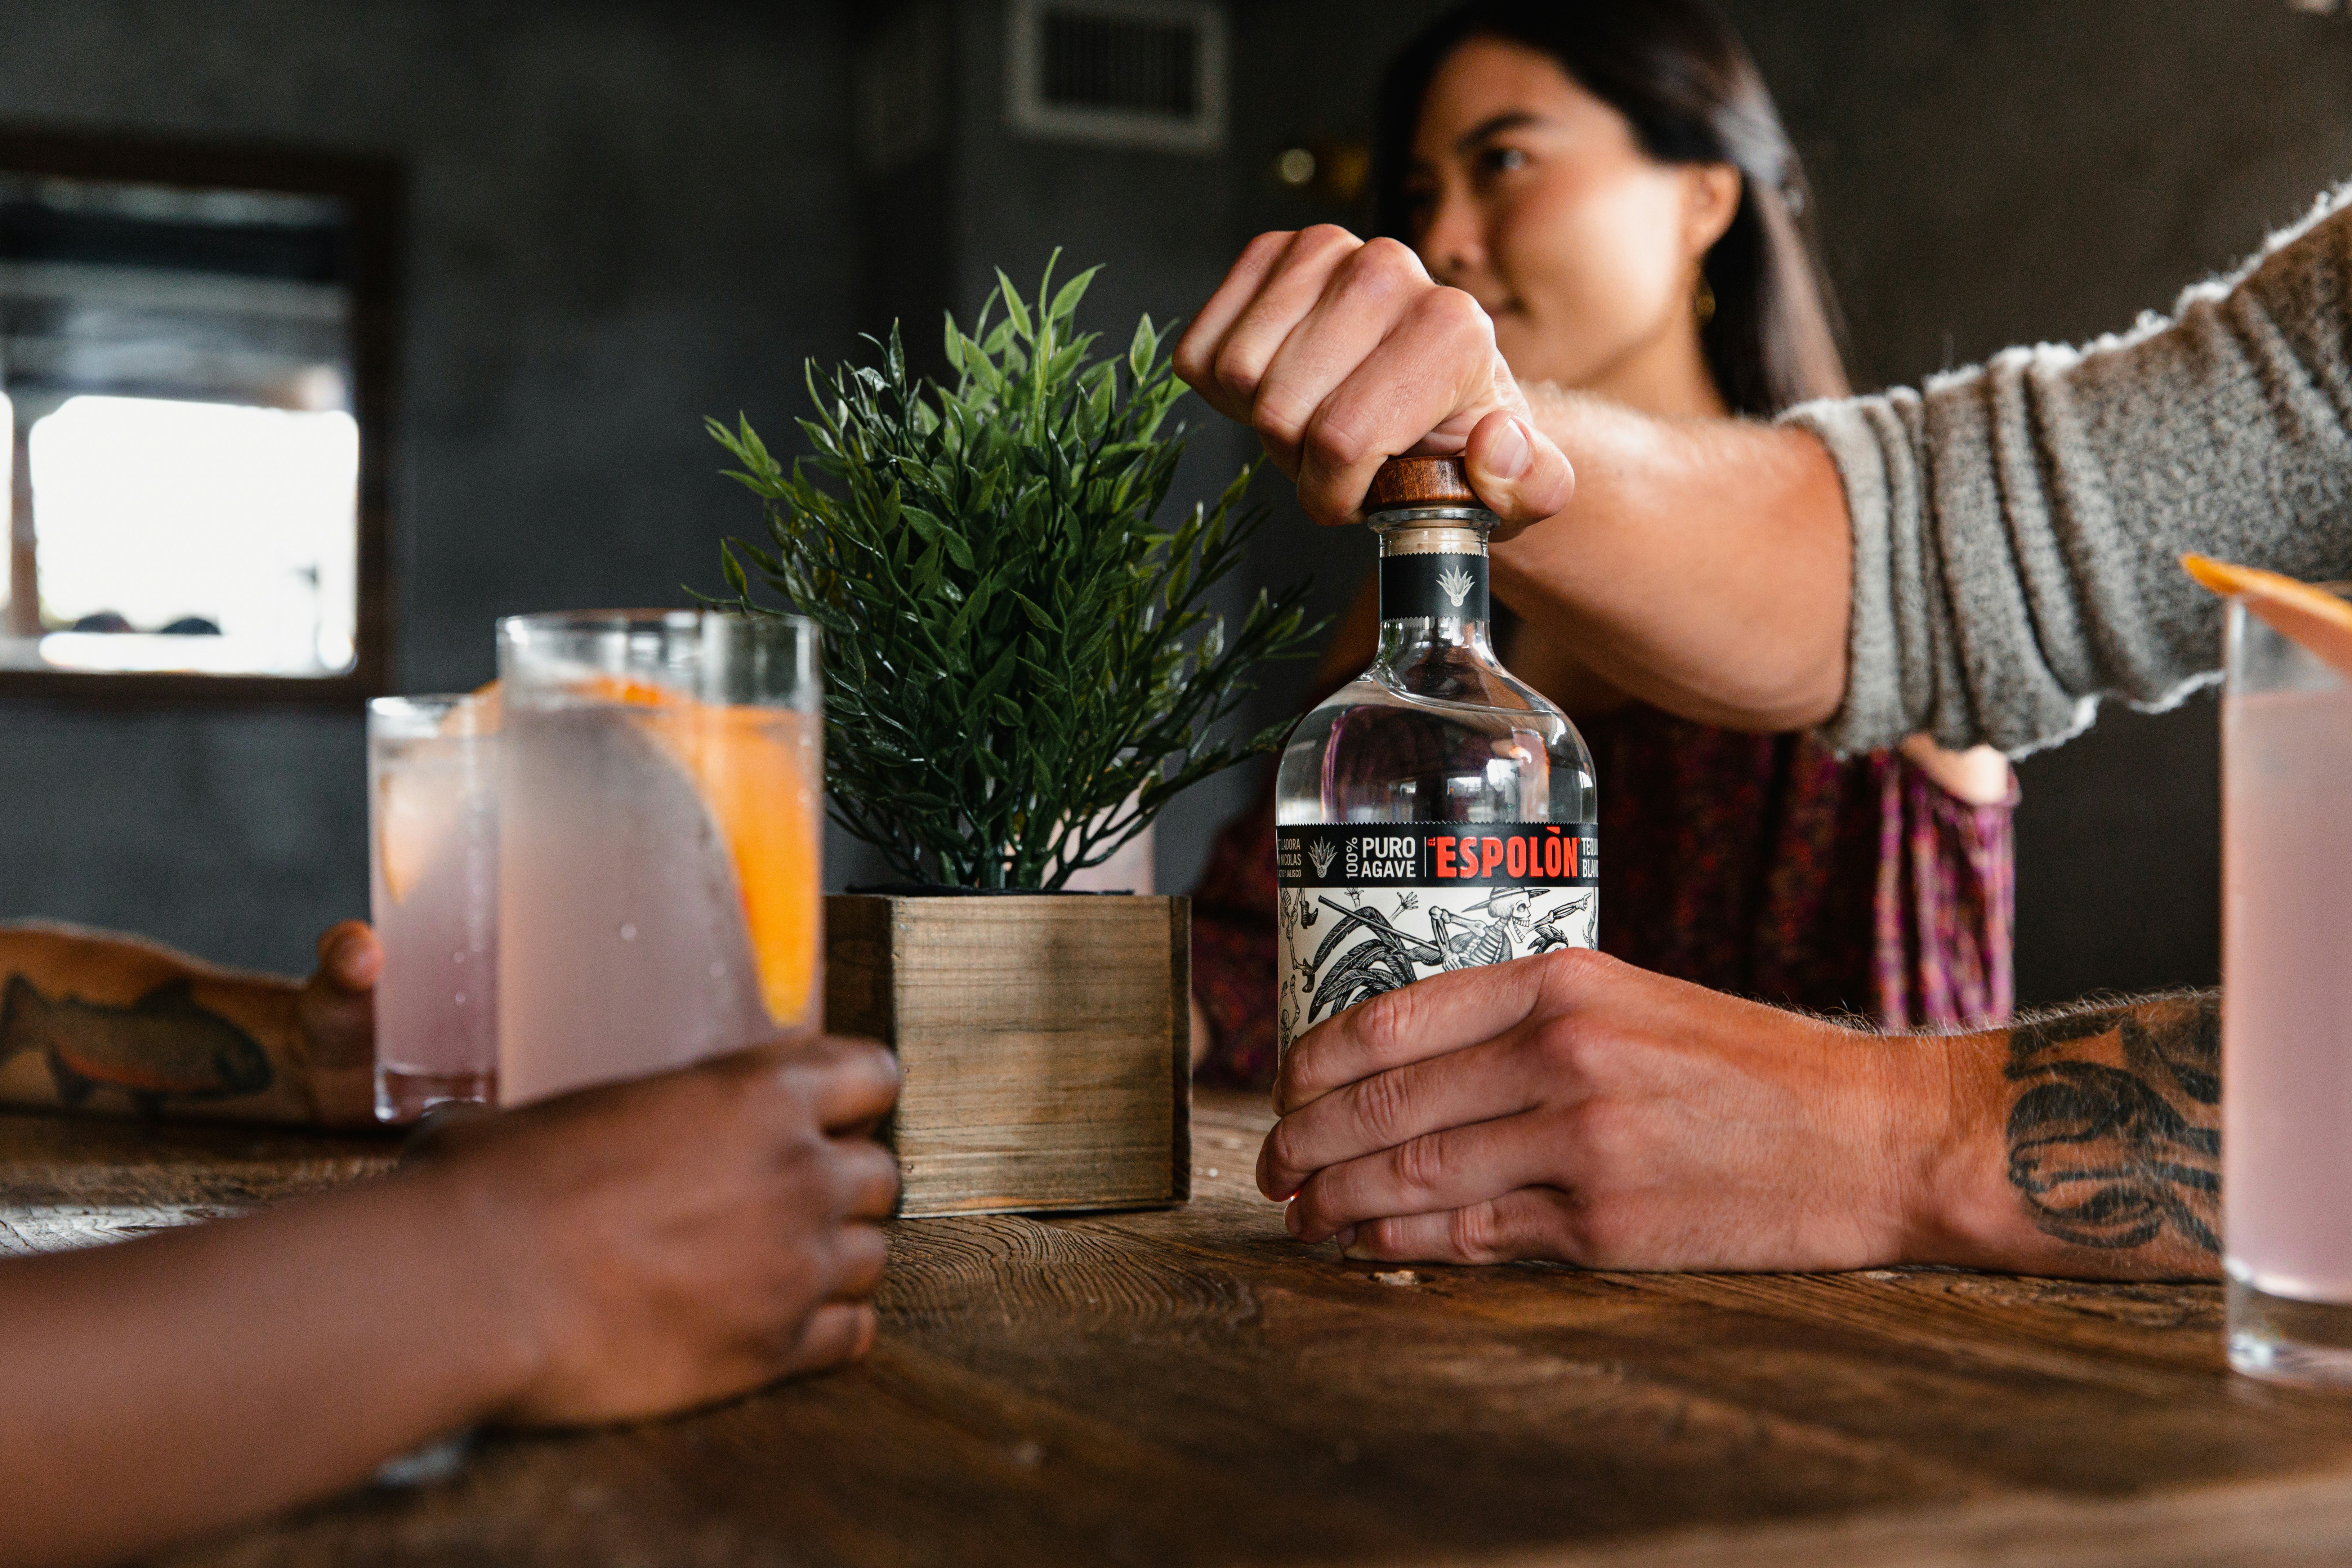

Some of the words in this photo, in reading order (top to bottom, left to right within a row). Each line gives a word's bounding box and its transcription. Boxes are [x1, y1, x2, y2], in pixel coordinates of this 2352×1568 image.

[1362, 836, 1416, 858] PURO
[1281, 854, 1302, 866] NICOLAS
[1346, 837, 1358, 879] 100%
[1286, 869, 1301, 878] JALISCO
[1361, 860, 1416, 877] AGAVE
